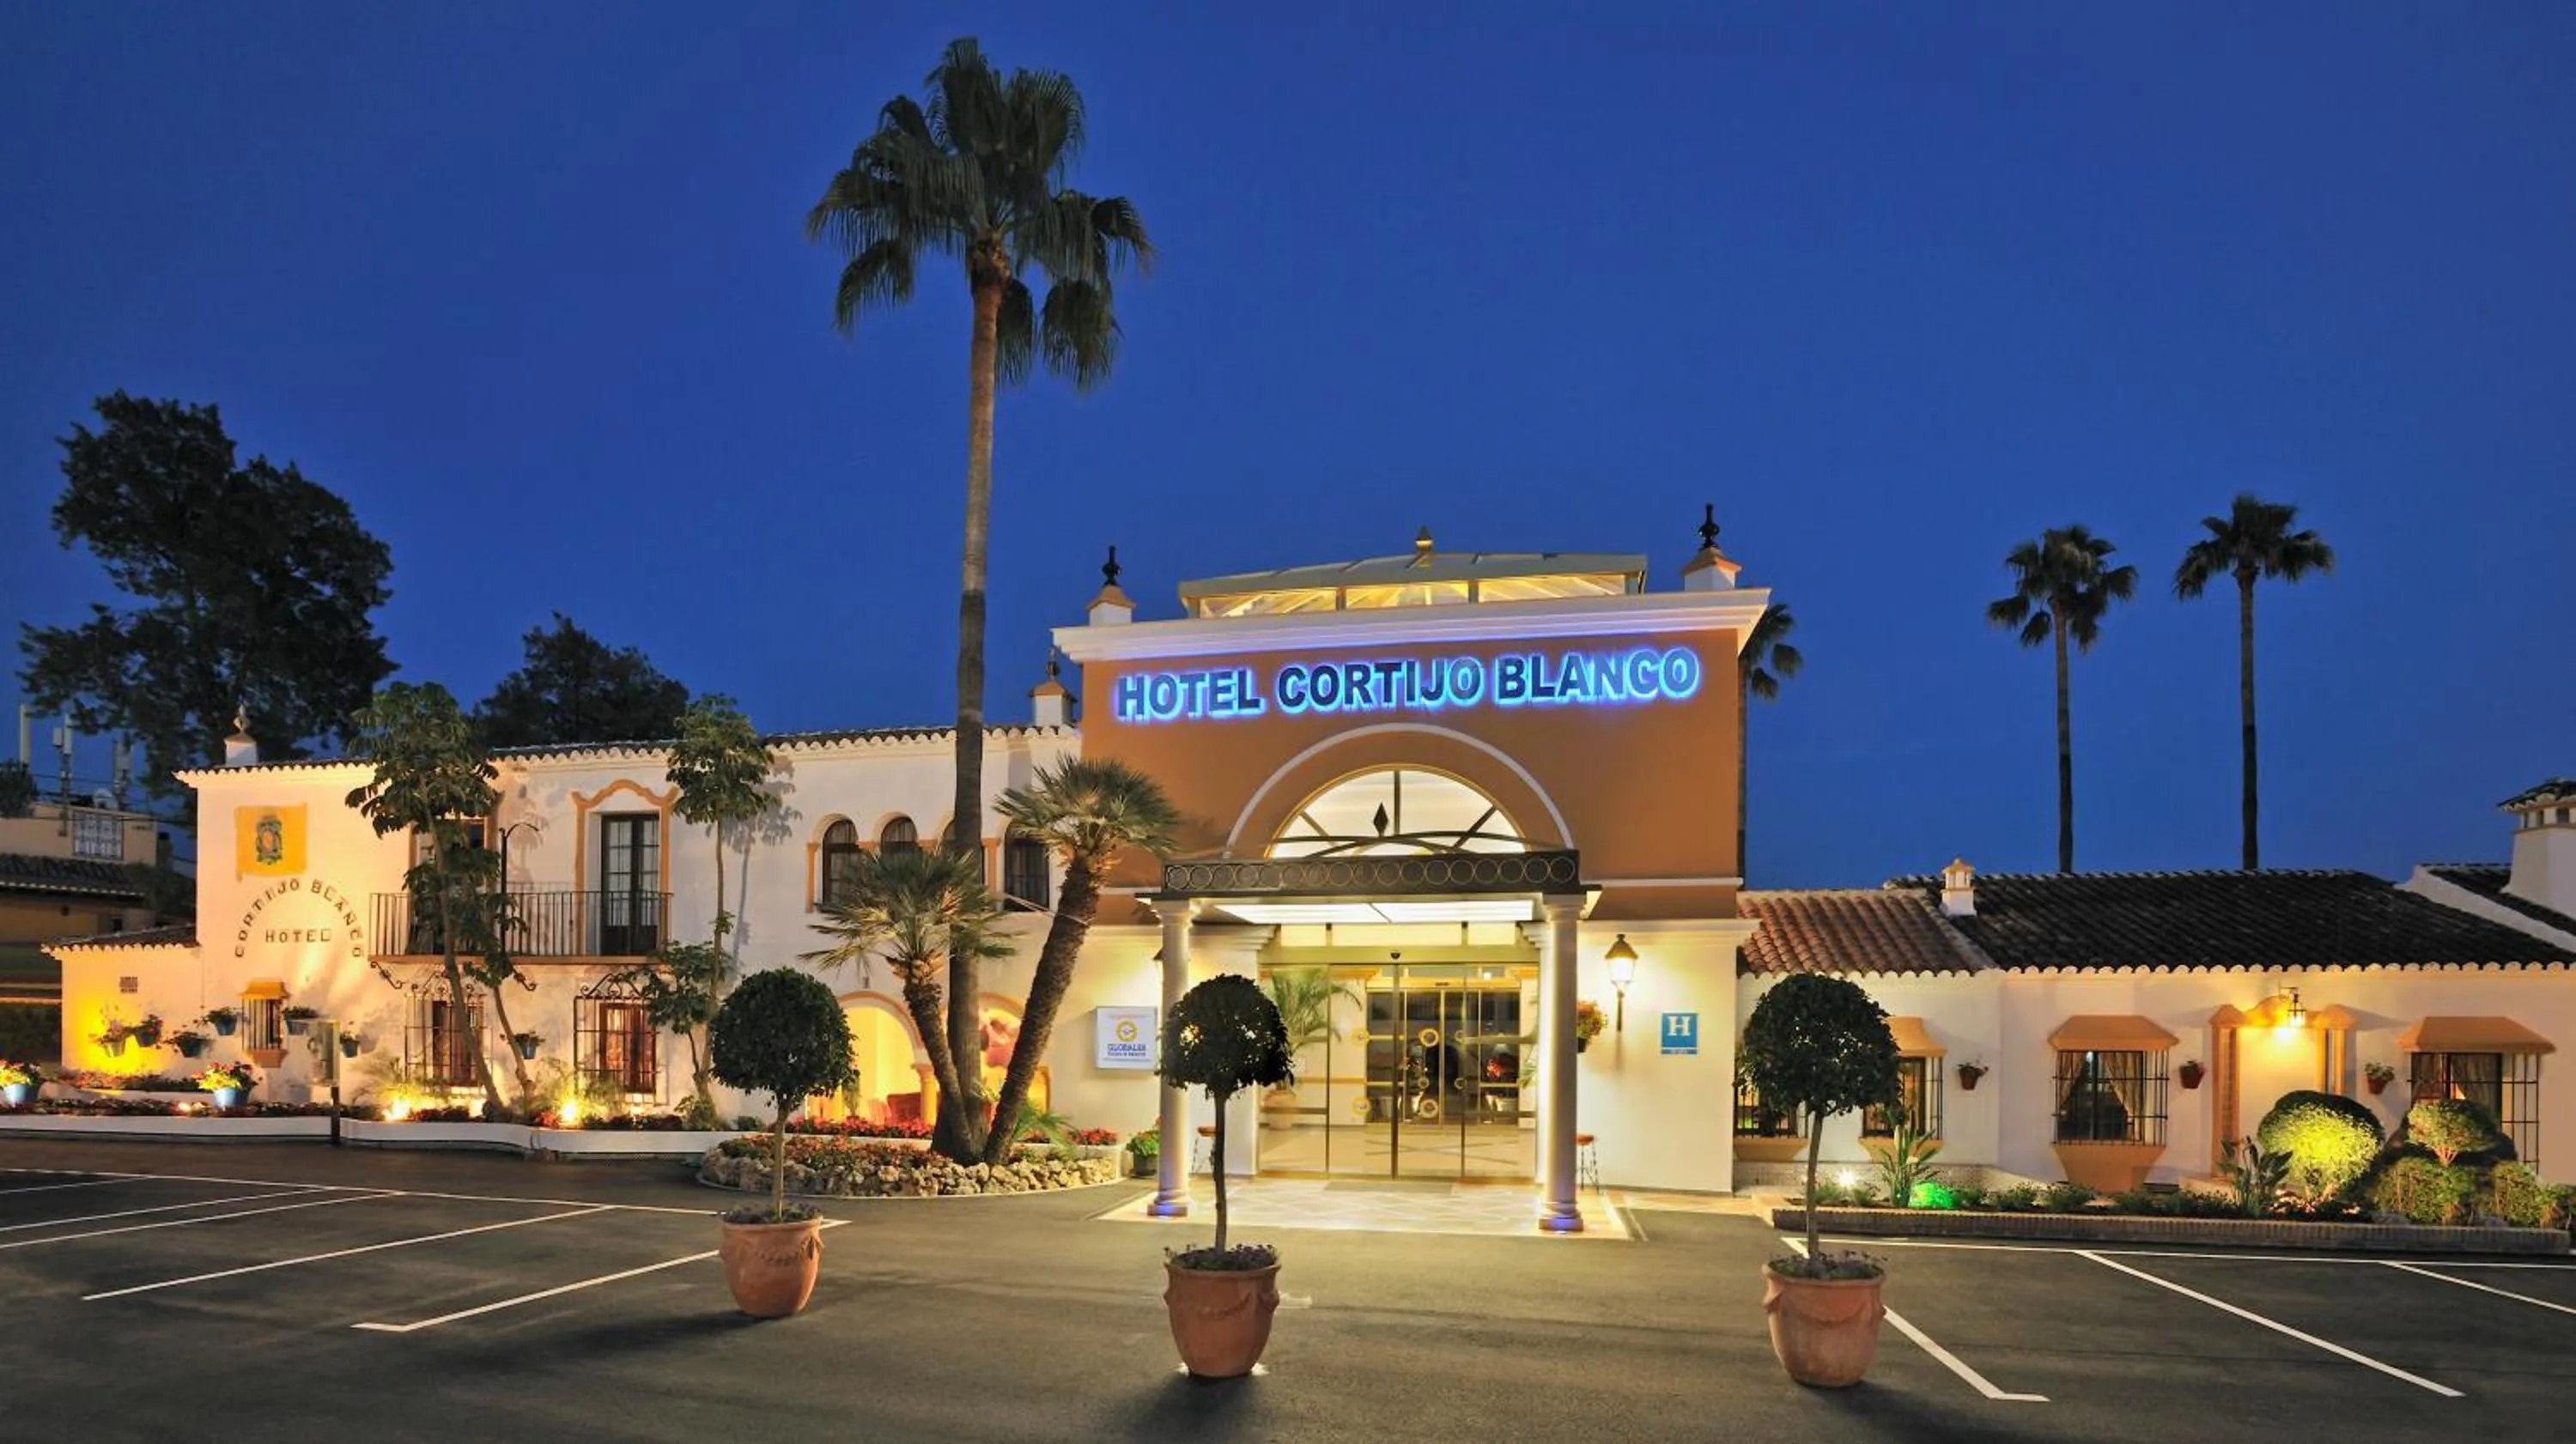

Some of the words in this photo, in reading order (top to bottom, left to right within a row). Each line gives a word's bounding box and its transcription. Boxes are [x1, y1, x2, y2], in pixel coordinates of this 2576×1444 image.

[1115, 670, 1265, 719] HOTEL
[1277, 657, 1485, 713] CORTIJO
[1496, 646, 1700, 704] BLANCO
[234, 878, 300, 957] CORTIJO
[310, 879, 364, 957] BLANCO
[265, 930, 331, 943] HOTEL
[1667, 1016, 1691, 1036] H
